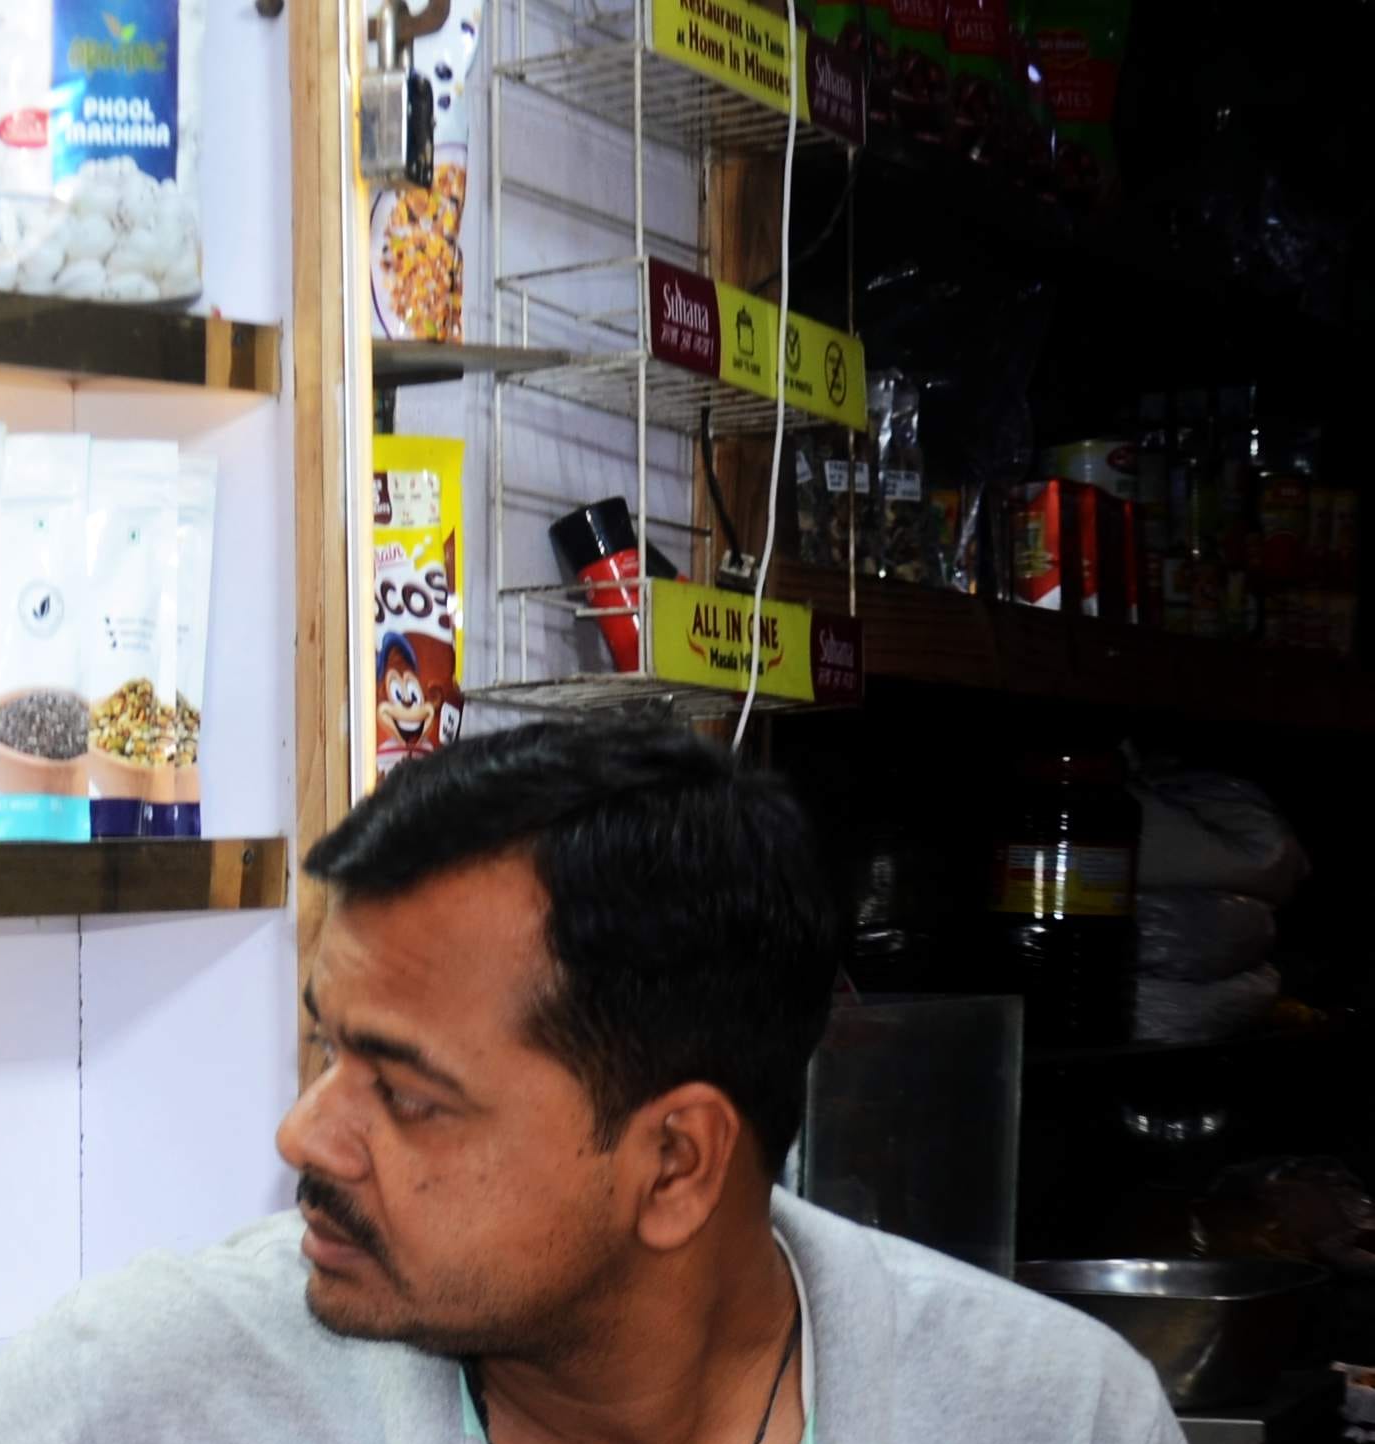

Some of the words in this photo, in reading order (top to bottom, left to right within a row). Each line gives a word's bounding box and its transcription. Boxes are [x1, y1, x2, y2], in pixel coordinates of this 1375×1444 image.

[689, 20, 725, 59] Home
[83, 96, 156, 122] PHOOL
[64, 121, 171, 148] MAKHANA
[663, 280, 710, 332] Suhana
[692, 602, 721, 638] ALL
[726, 608, 742, 643] IN
